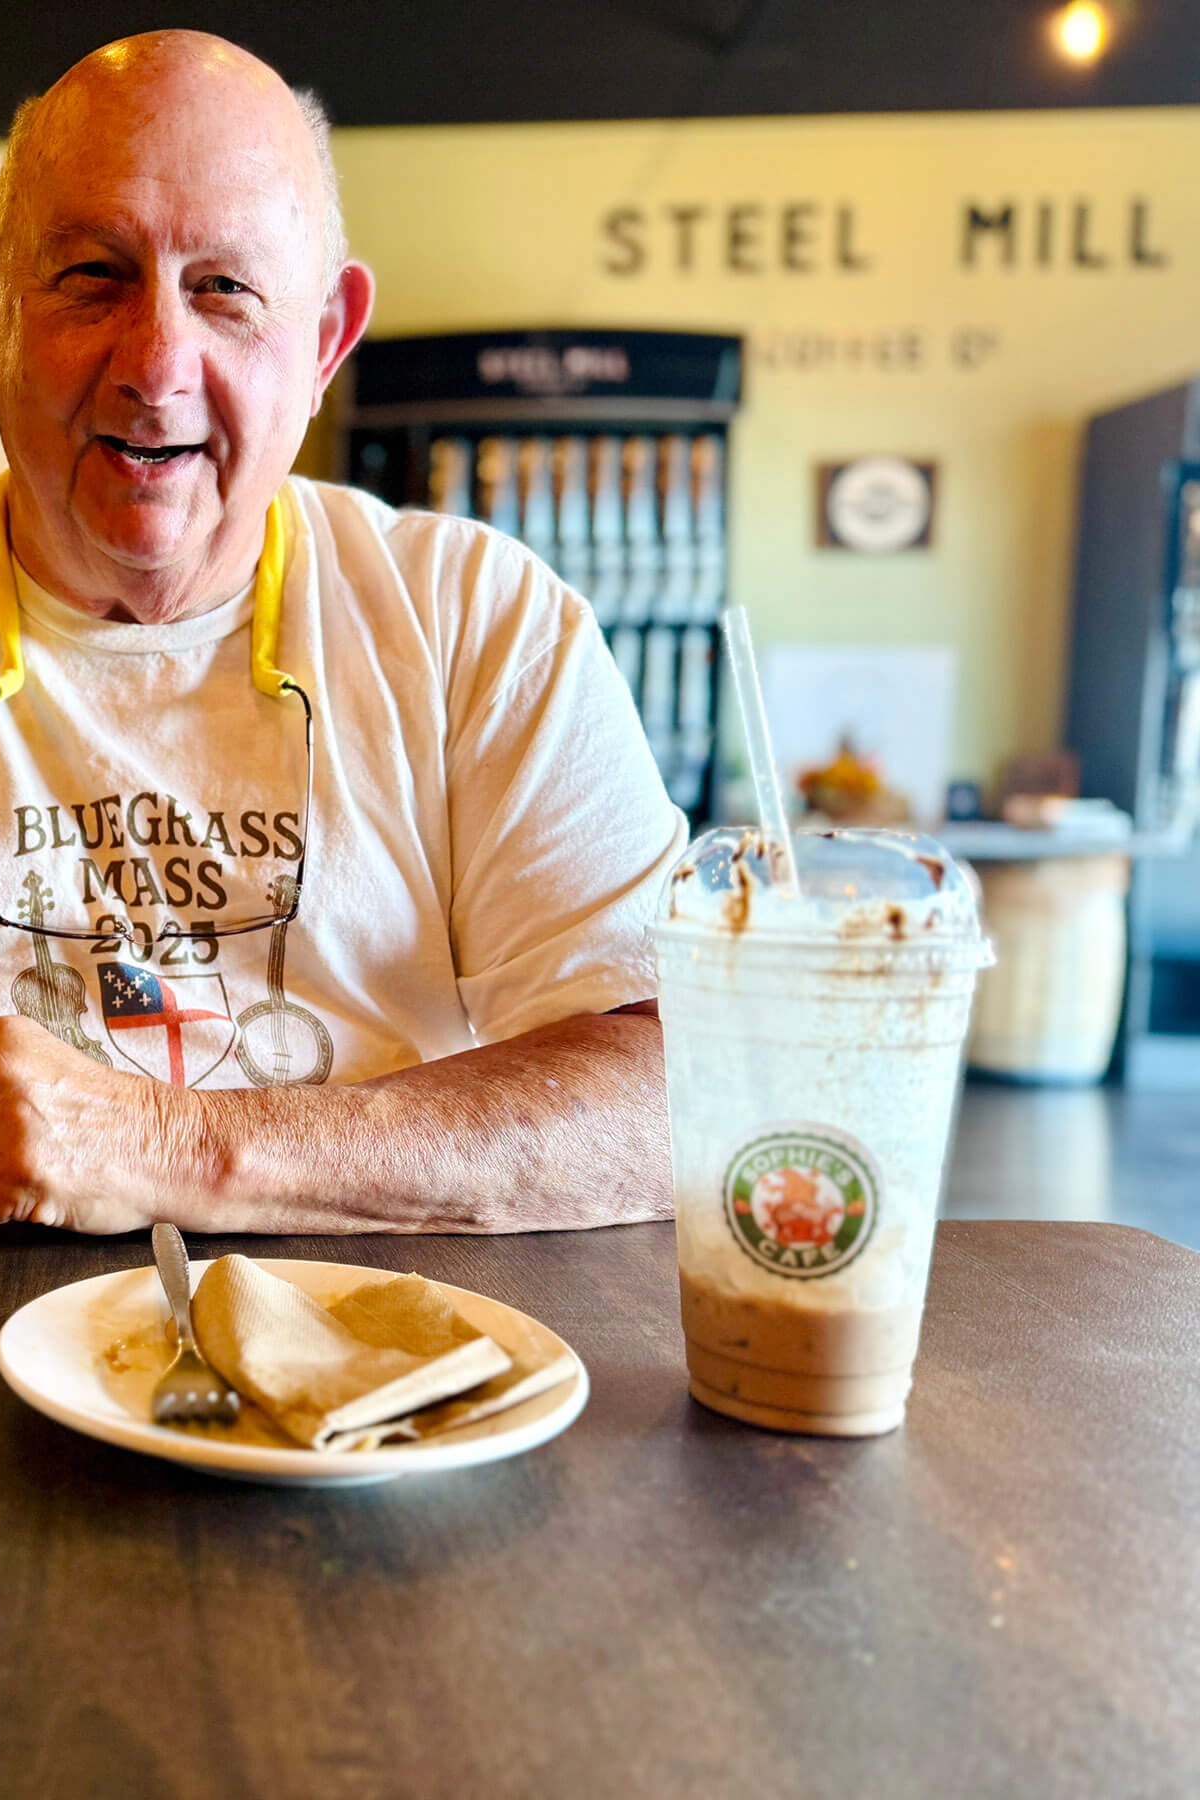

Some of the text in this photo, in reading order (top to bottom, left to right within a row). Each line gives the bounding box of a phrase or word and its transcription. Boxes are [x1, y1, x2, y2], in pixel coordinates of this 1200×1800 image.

[602, 196, 1171, 276] STEEL MILL
[13, 791, 303, 862] BLUEGRASS
[79, 856, 228, 911] MASS
[90, 913, 220, 966] 2025
